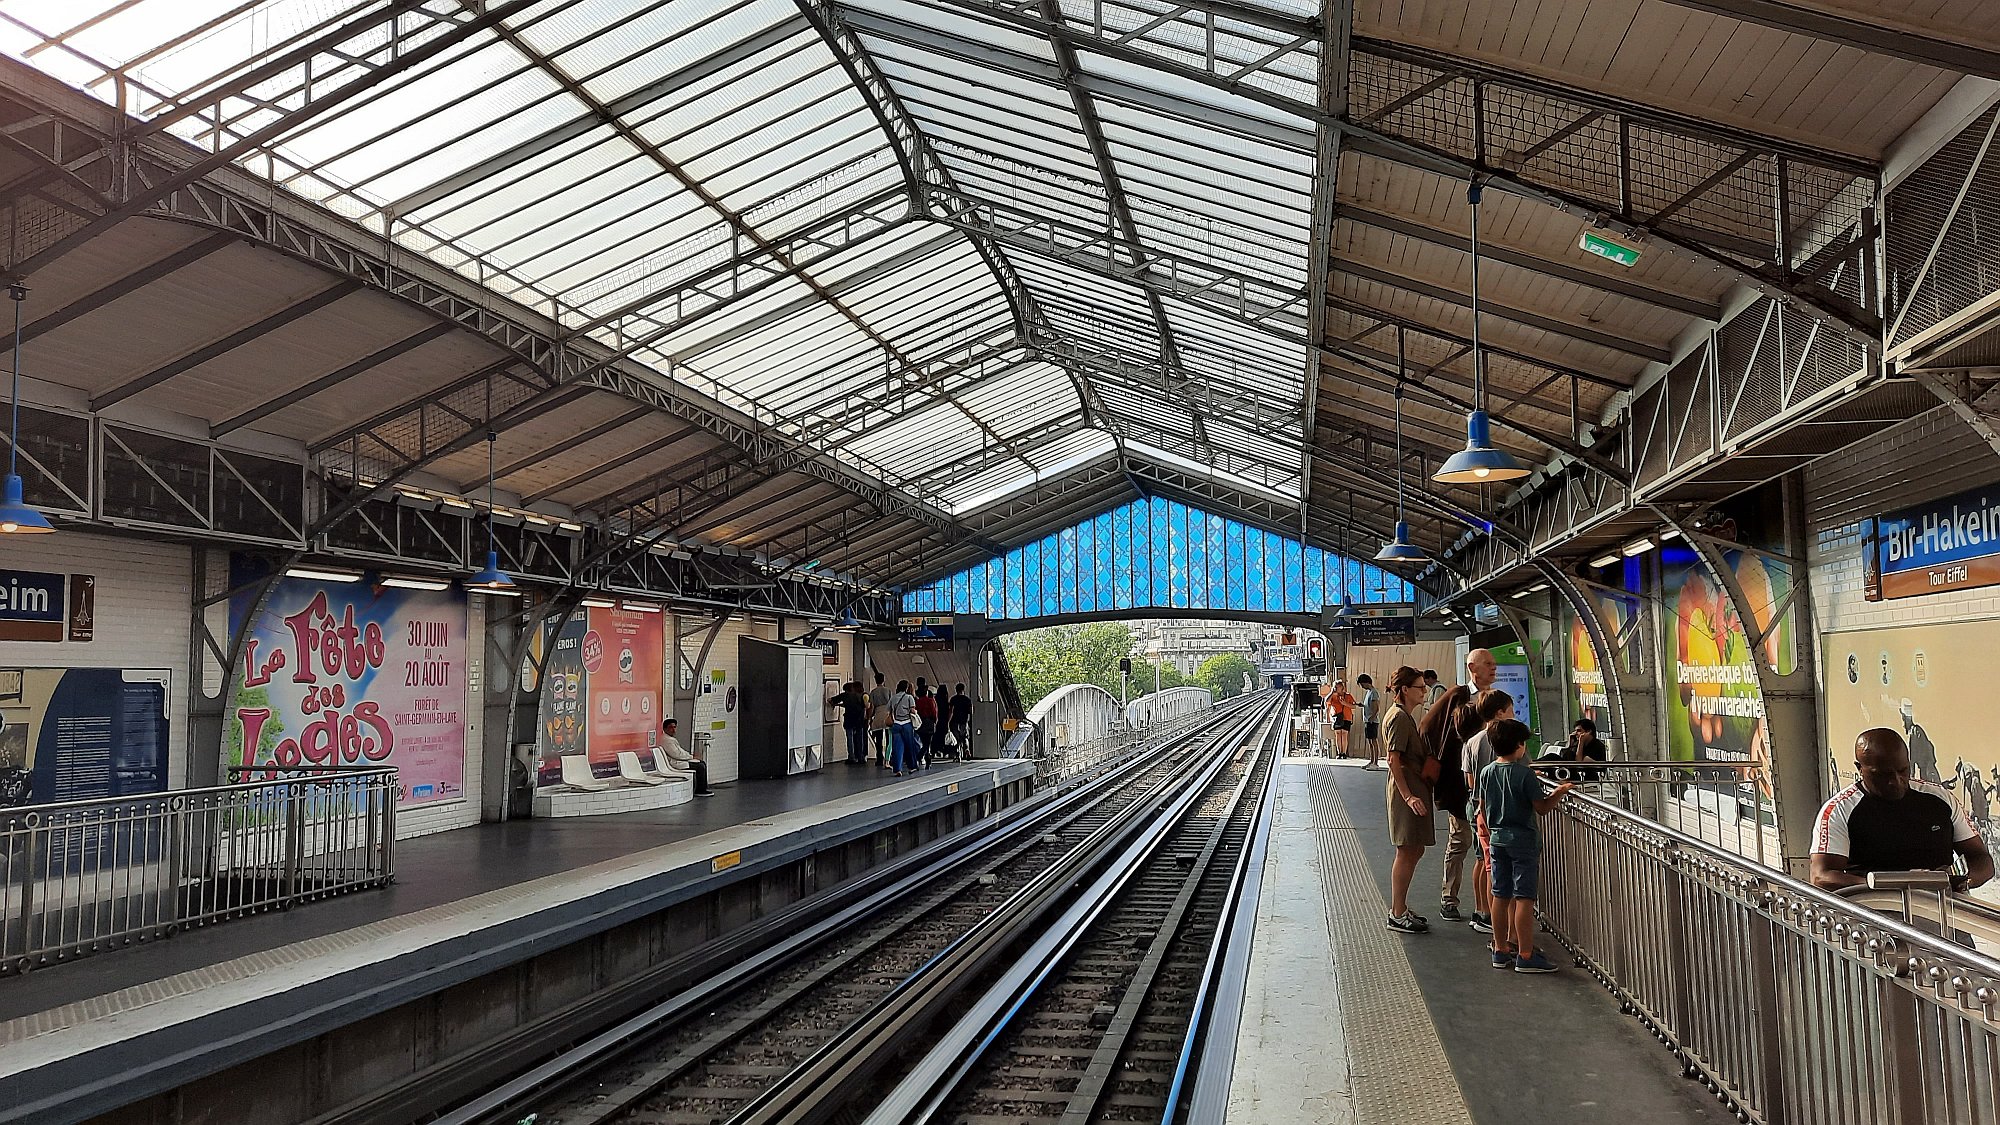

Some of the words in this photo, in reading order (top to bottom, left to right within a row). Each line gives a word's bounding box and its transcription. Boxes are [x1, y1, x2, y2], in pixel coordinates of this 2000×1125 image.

[1929, 571, 1946, 586] Tour
[1947, 565, 1968, 583] Eiffel
[284, 591, 384, 683] Fête
[408, 621, 421, 646] 30
[424, 622, 448, 647] JUIN
[425, 648, 432, 659] AU
[405, 661, 419, 687] 20
[422, 654, 450, 687] AOÛT
[1677, 660, 1708, 684] Derrière
[1708, 660, 1741, 690] chaque
[301, 684, 345, 715] des
[1708, 697, 1719, 715] un
[1720, 691, 1761, 718] maraîche
